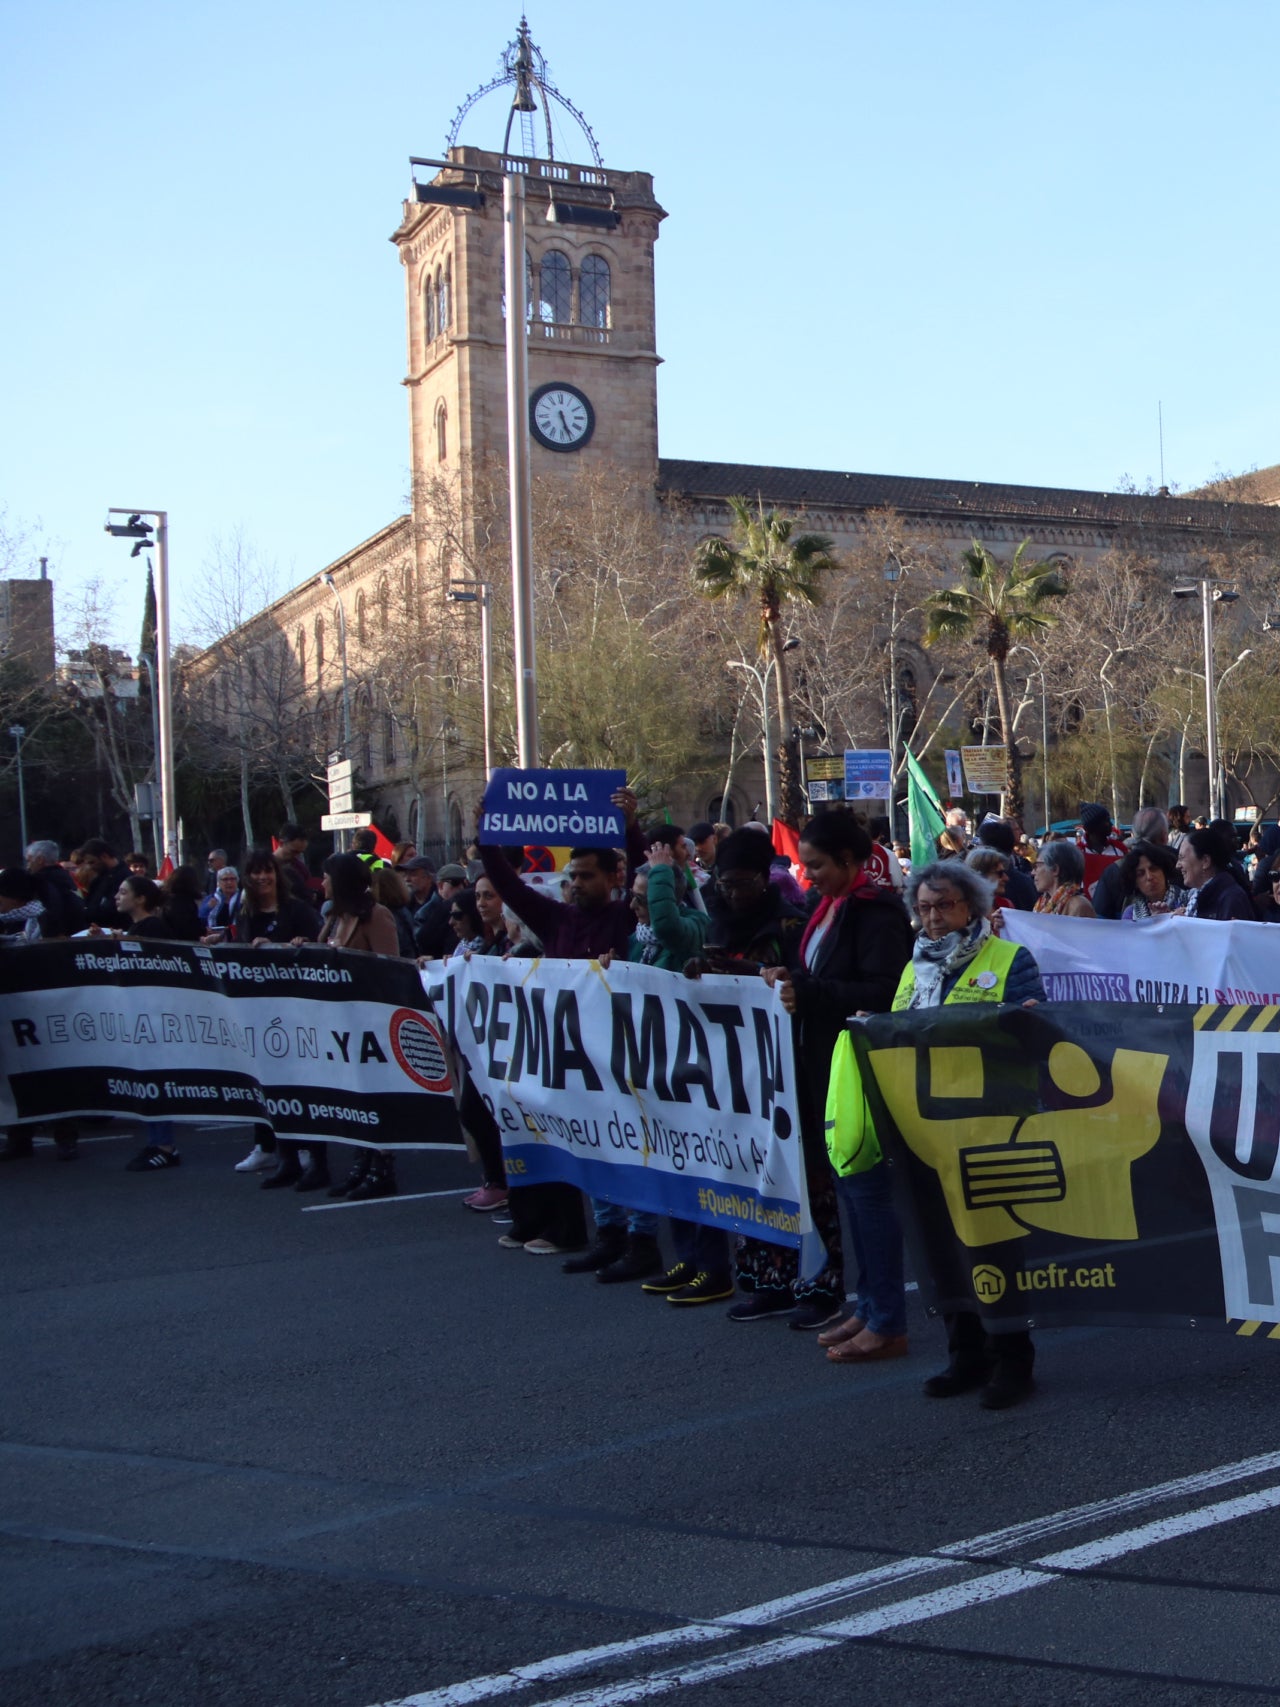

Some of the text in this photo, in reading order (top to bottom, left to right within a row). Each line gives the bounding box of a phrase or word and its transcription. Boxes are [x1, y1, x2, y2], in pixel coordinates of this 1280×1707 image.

[507, 782, 588, 801] NO A LA
[483, 810, 620, 834] ISLAMOFÒBIA
[1043, 974, 1125, 1004] EMINISTES
[1135, 979, 1189, 1005] CONTRA
[164, 1082, 216, 1099] firmas
[222, 1085, 255, 1102] para
[308, 1103, 379, 1126] personas
[607, 1110, 637, 1151] de
[637, 1115, 733, 1171] Migració
[1016, 1264, 1116, 1292] ucfr.cat
